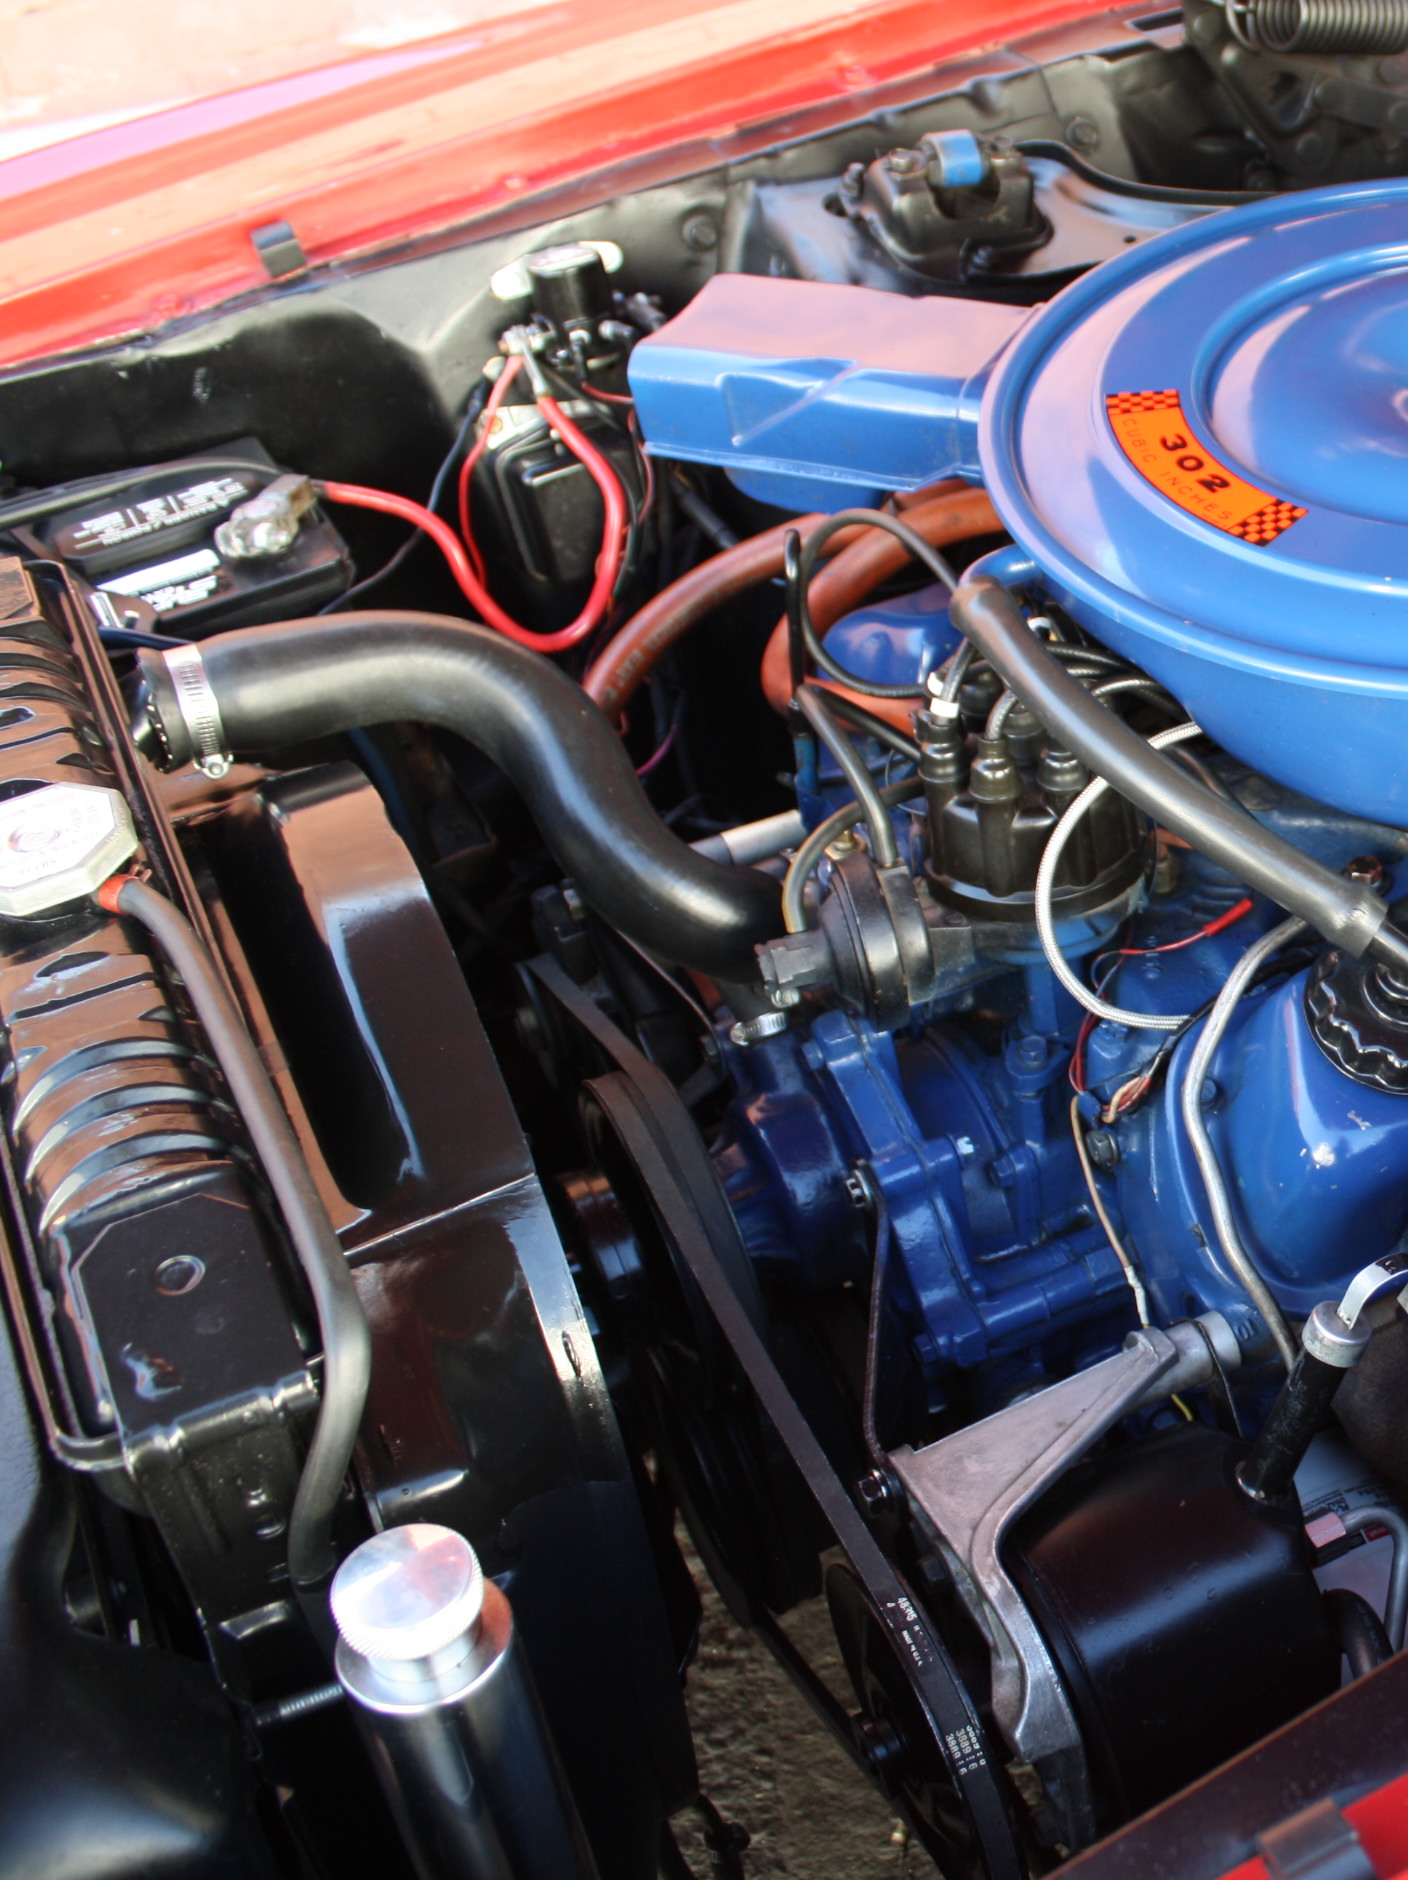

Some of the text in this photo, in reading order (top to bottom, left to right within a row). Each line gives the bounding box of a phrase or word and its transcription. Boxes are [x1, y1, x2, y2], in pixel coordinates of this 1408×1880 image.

[1122, 418, 1233, 521] CUBIC INCHES
[1159, 433, 1231, 494] 302
